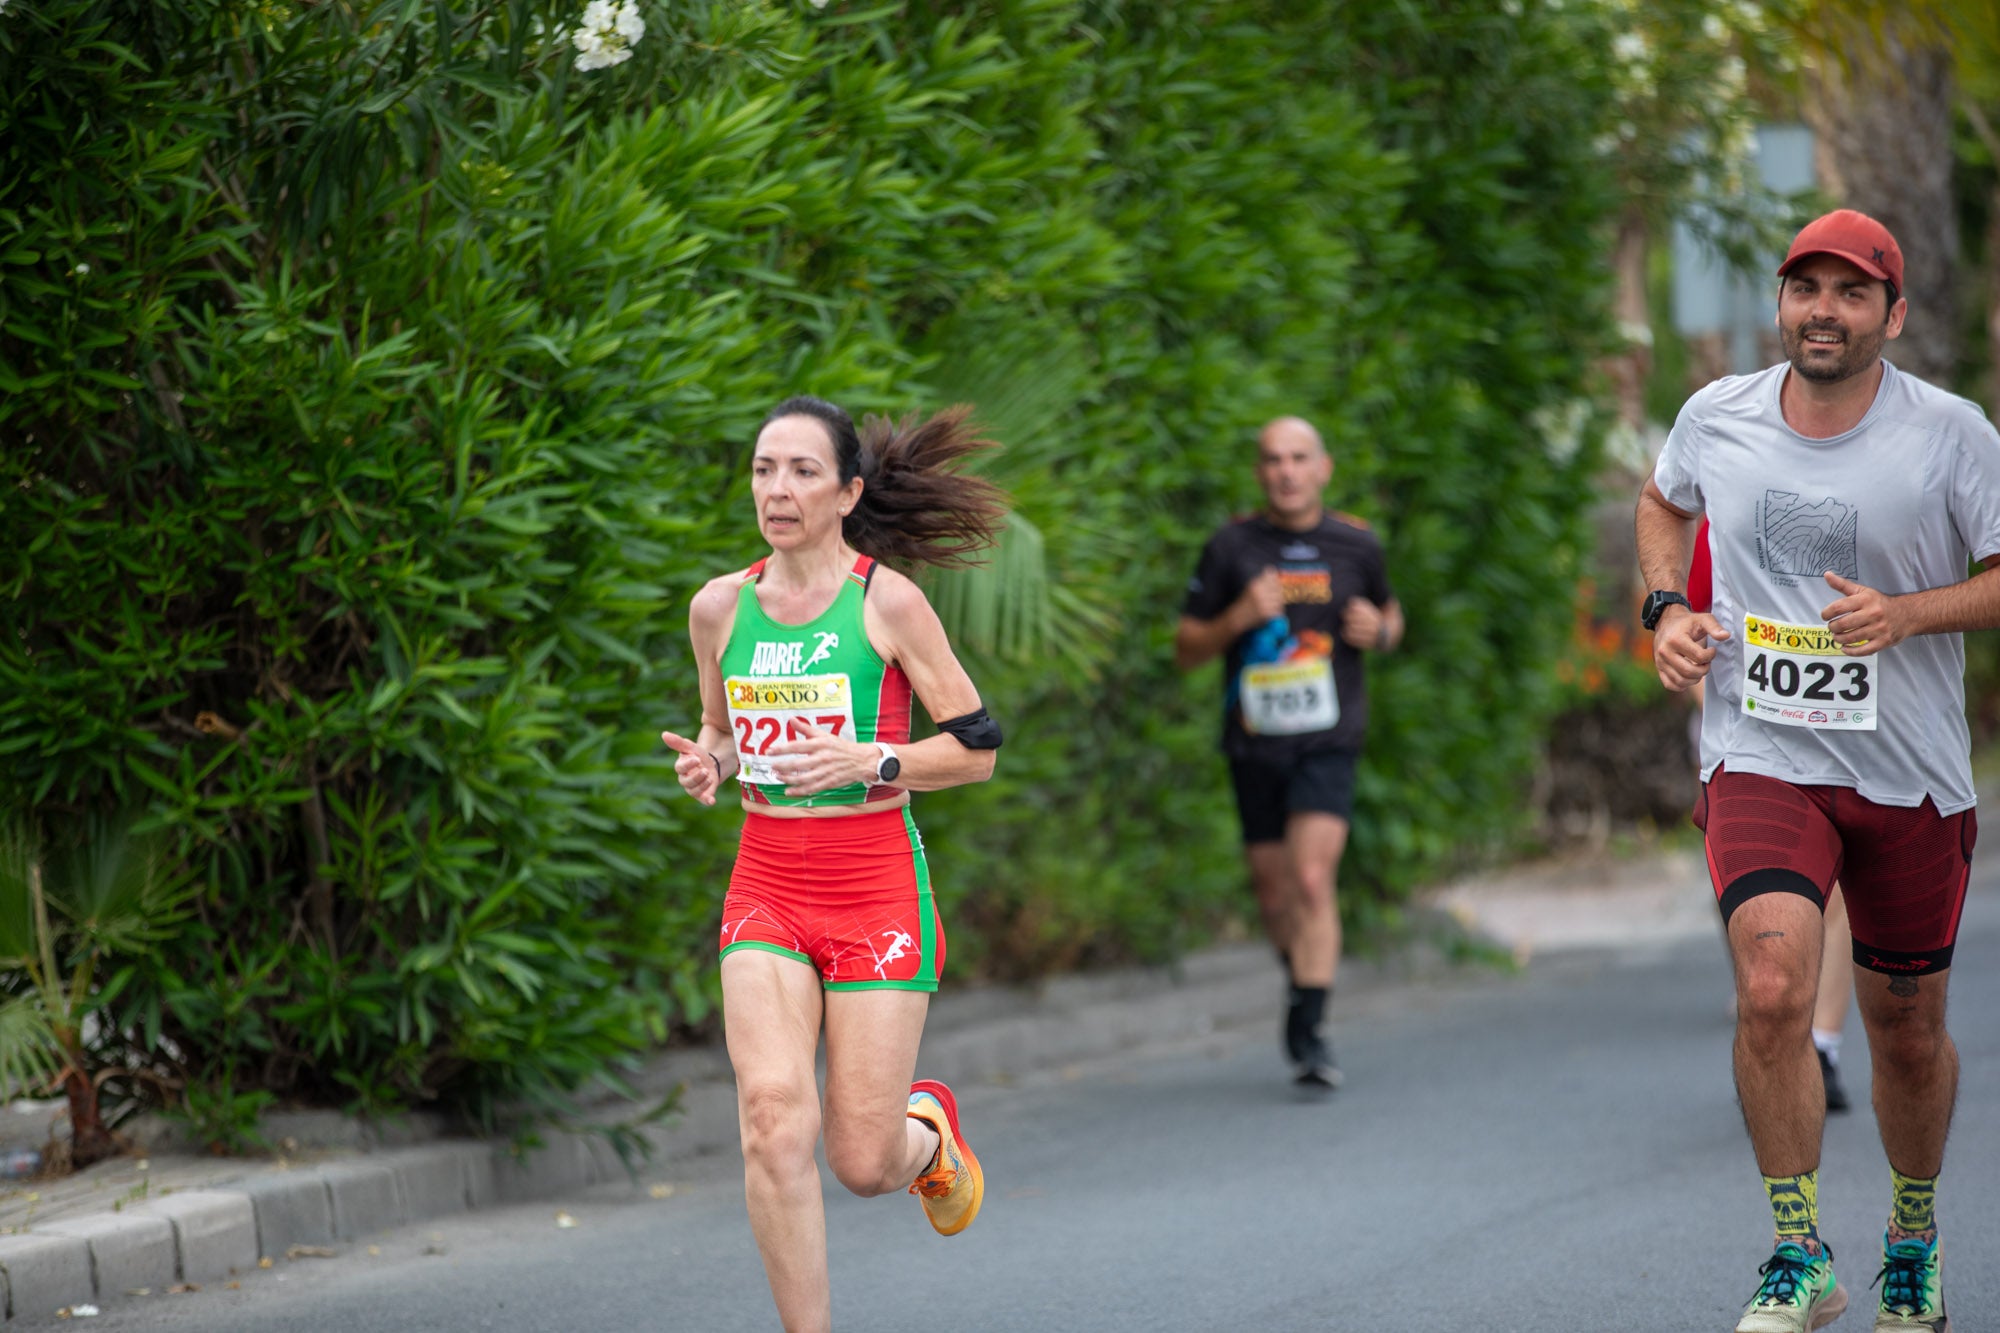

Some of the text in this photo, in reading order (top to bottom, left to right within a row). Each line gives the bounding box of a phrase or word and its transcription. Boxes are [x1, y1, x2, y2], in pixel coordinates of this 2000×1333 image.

[1760, 623, 1834, 643] 38 GRAN PREM
[1776, 632, 1842, 650] FONDO
[749, 641, 804, 674] ATARFE
[1747, 653, 1870, 702] 4023
[739, 685, 754, 703] 38
[780, 682, 812, 690] PREMIO
[754, 690, 819, 704] FONDO
